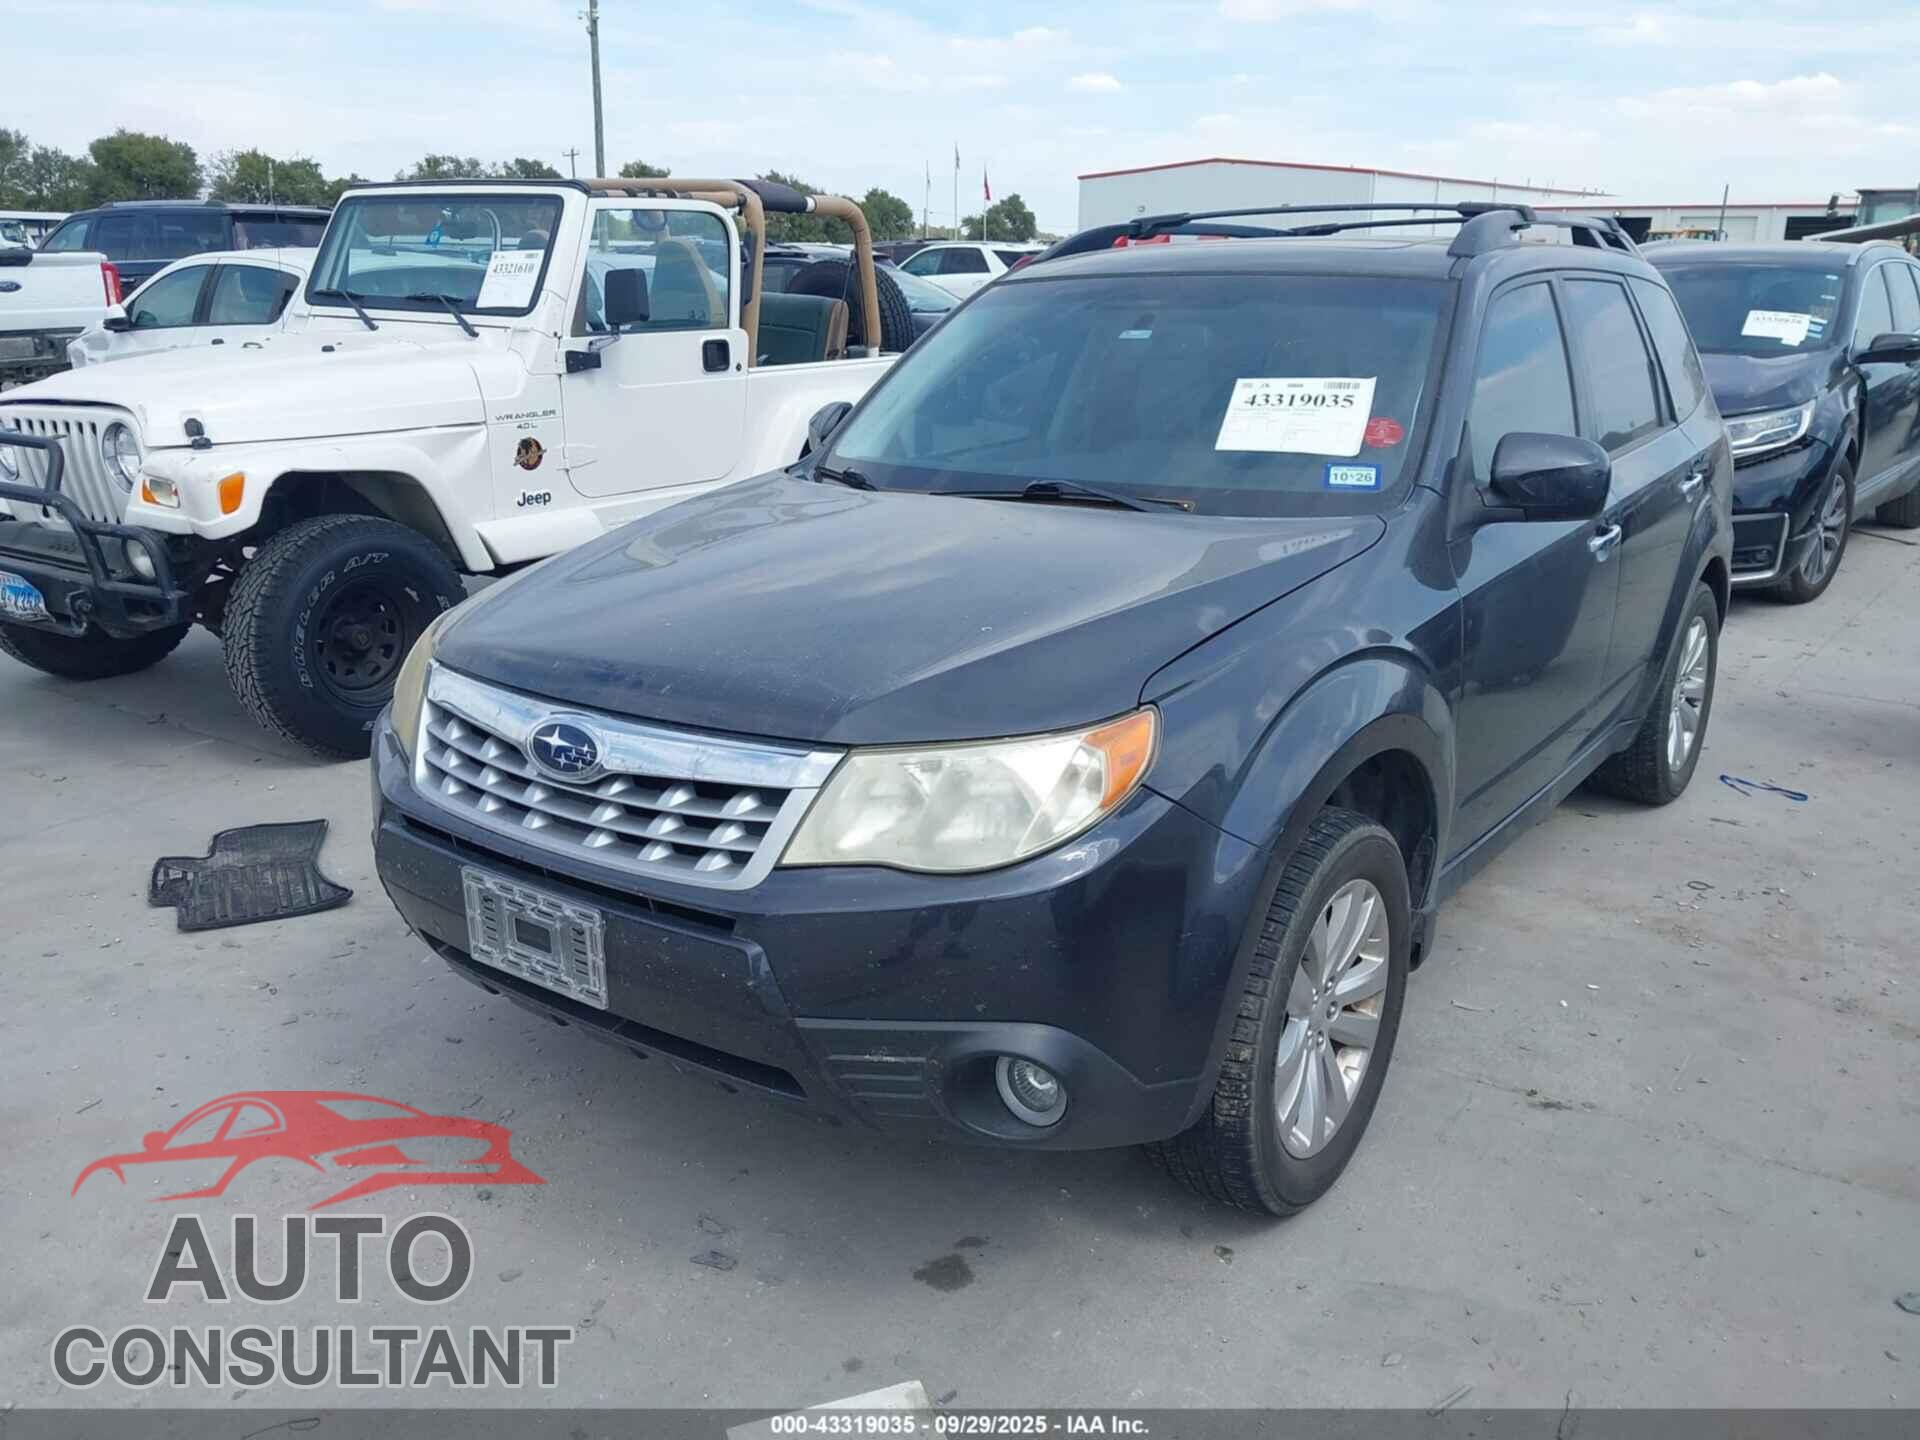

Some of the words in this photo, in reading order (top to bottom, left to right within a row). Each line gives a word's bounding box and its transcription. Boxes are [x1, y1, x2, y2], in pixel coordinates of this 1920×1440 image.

[1243, 393, 1356, 409] 43319035
[495, 409, 556, 421] WRANGLER
[517, 491, 552, 507] Jeep
